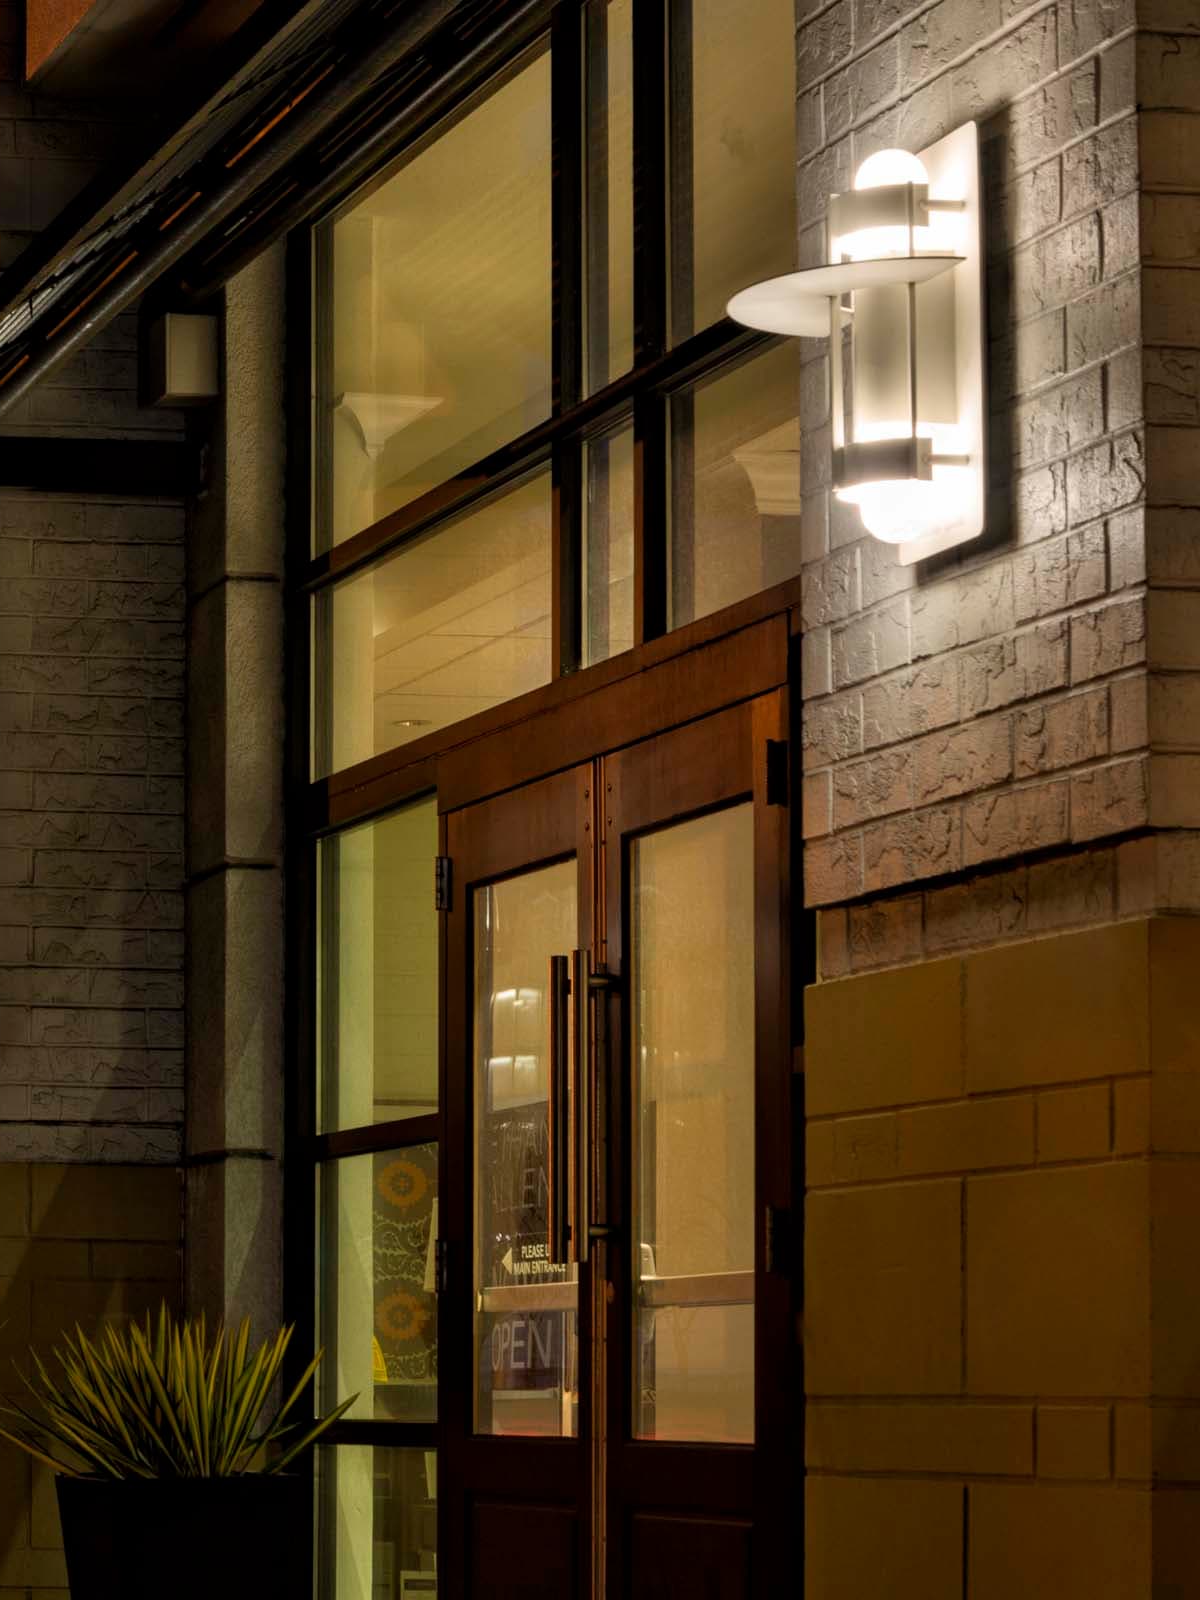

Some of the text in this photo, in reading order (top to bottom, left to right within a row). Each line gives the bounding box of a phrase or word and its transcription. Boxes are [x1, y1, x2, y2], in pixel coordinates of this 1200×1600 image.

[521, 1244, 545, 1259] PLEASE
[513, 1262, 531, 1274] MAIN
[491, 1320, 552, 1371] OPEN
